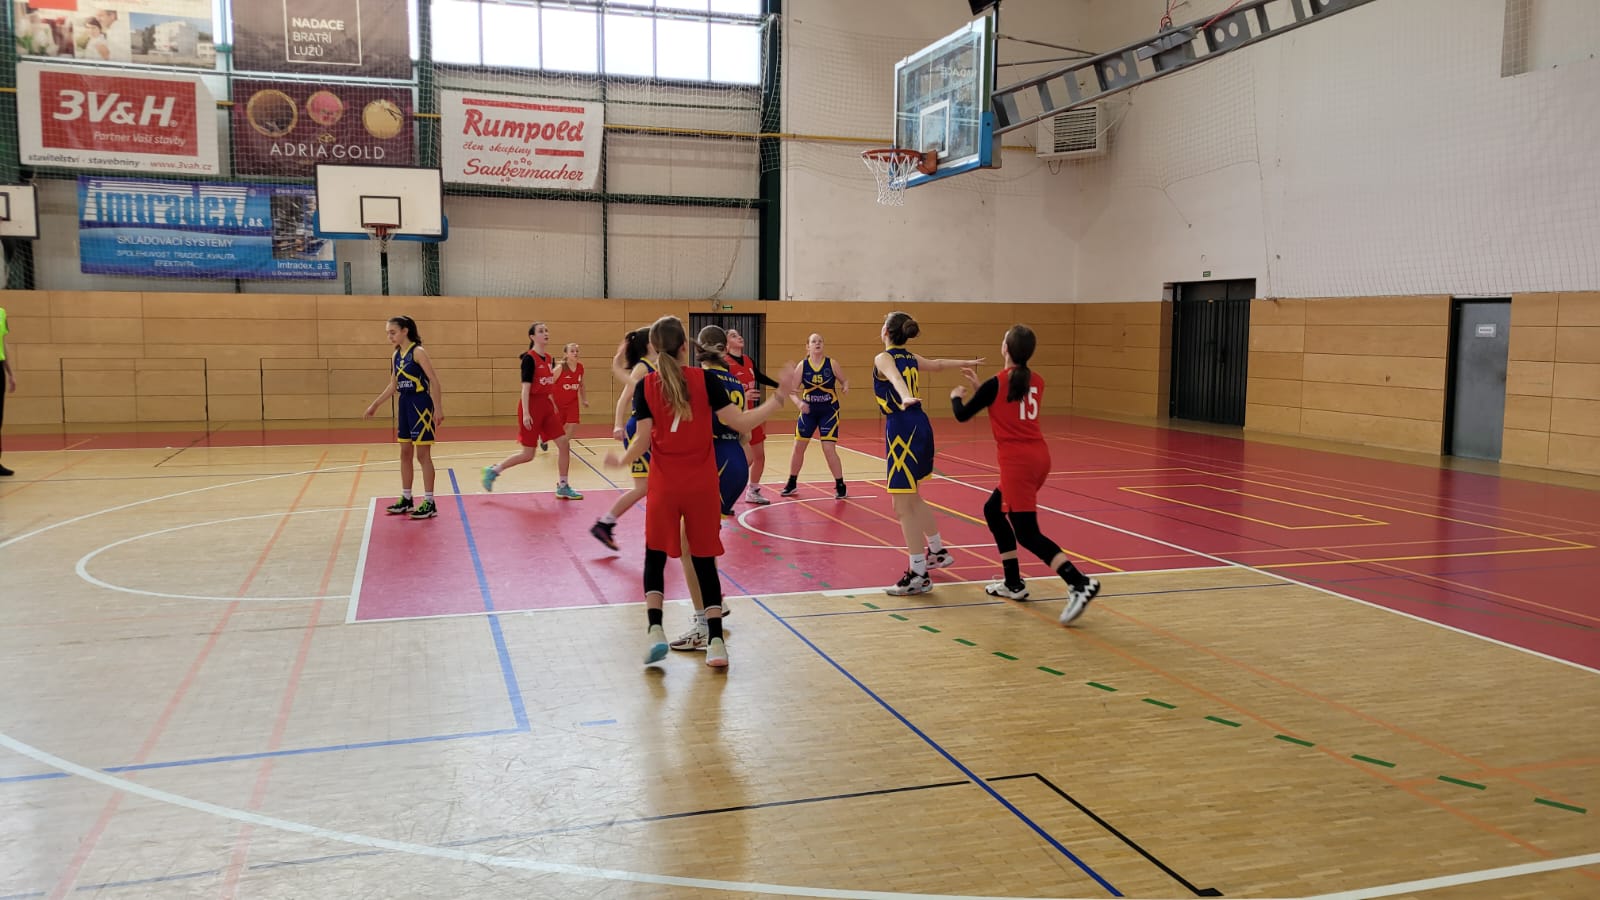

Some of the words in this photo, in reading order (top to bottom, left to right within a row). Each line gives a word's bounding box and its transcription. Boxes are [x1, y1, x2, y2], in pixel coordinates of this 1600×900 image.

[291, 17, 345, 31] NADACE
[52, 89, 176, 127] 3V&H
[462, 108, 585, 144] Rumpold
[93, 131, 130, 142] Partner
[153, 135, 186, 147] stavby
[489, 143, 532, 156] skupiny
[88, 157, 140, 168] stavebniny
[150, 160, 213, 171] www.3vah.cz
[463, 158, 584, 181] Saubermacher
[117, 235, 183, 246] SKLADOVACÍ
[811, 374, 824, 384] 45
